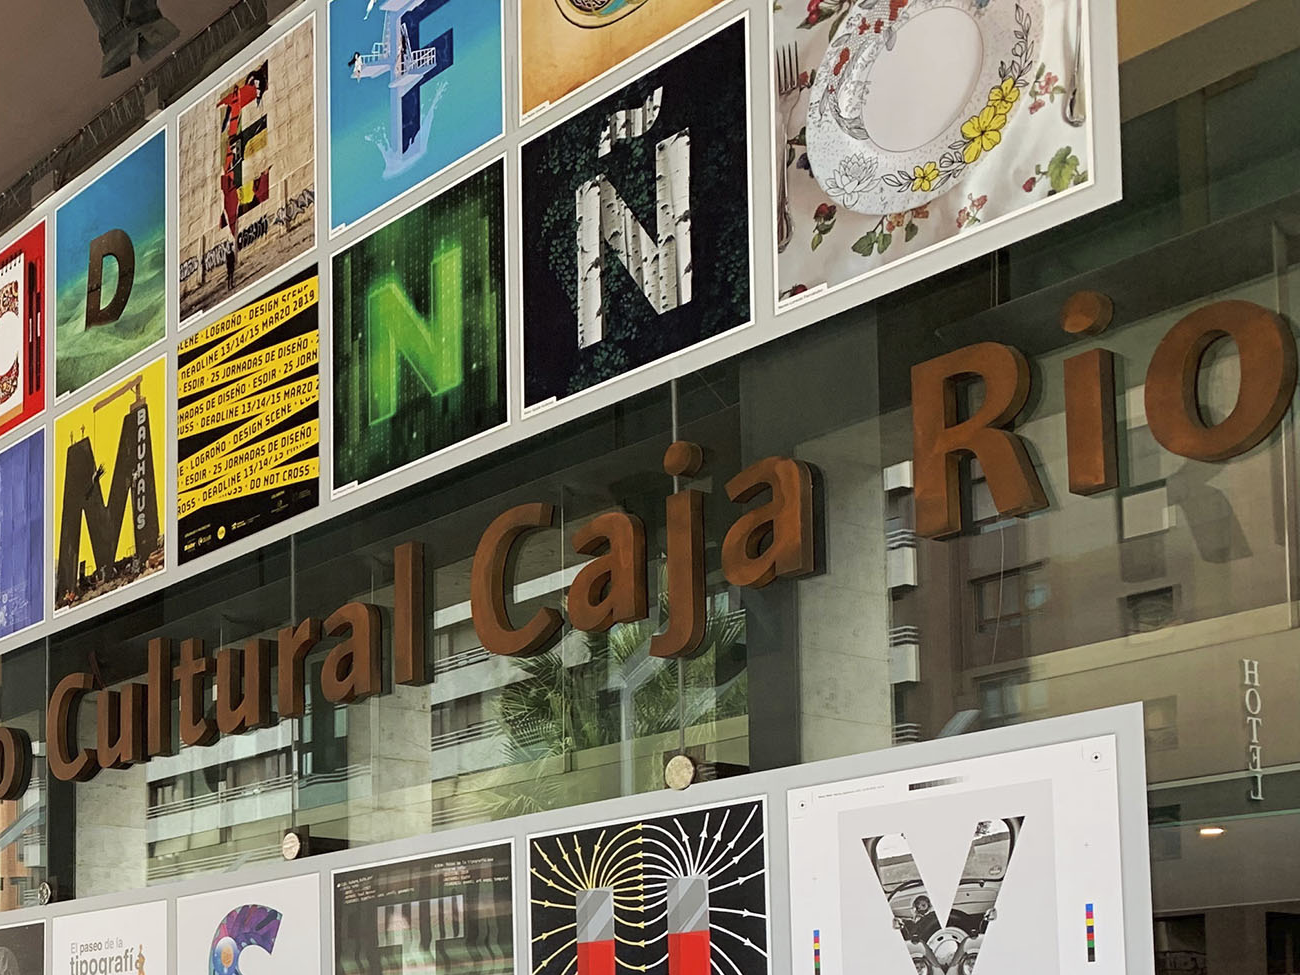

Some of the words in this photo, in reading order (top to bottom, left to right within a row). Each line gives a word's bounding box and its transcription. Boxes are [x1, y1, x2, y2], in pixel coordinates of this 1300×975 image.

[84, 229, 136, 332] D
[205, 313, 242, 340] LOGROÑO
[249, 297, 279, 321] DESIGN
[220, 324, 260, 357] 13/14/15
[262, 305, 290, 332] MARZO
[293, 289, 316, 312] 2019
[368, 246, 463, 427] N
[178, 403, 204, 424] NADAS
[206, 400, 216, 412] DE
[217, 382, 246, 406] DISEÑO
[253, 368, 277, 389] ESDIR
[283, 360, 293, 375] 25
[183, 376, 205, 393] ESDIR
[210, 370, 220, 384] 25
[221, 355, 263, 377] JORNADAS
[265, 350, 276, 363] DE
[277, 337, 309, 360] DISEÑO
[190, 441, 227, 470] LOGROÑO
[233, 418, 263, 445] DESIGN
[265, 402, 292, 426] SCENE
[200, 406, 239, 428] DEADLINE
[241, 391, 281, 415] 13/14/15
[283, 380, 314, 401] MARZO
[136, 408, 147, 530] BAUHAUS
[185, 468, 207, 487] ESDIR
[213, 462, 222, 475] 25
[223, 444, 266, 471] JORNADAS
[267, 439, 279, 454] DE
[280, 425, 312, 448] DISEÑO
[202, 472, 242, 502] DEADLINE
[250, 477, 262, 490] DO
[263, 471, 280, 487] NOT
[282, 464, 310, 482] CROSS
[47, 541, 432, 782] Cultural
[470, 440, 825, 660] Caja
[909, 291, 1300, 540] Rio
[56, 402, 161, 609] M
[79, 941, 103, 956] paseo
[104, 938, 114, 950] de
[116, 936, 123, 948] la
